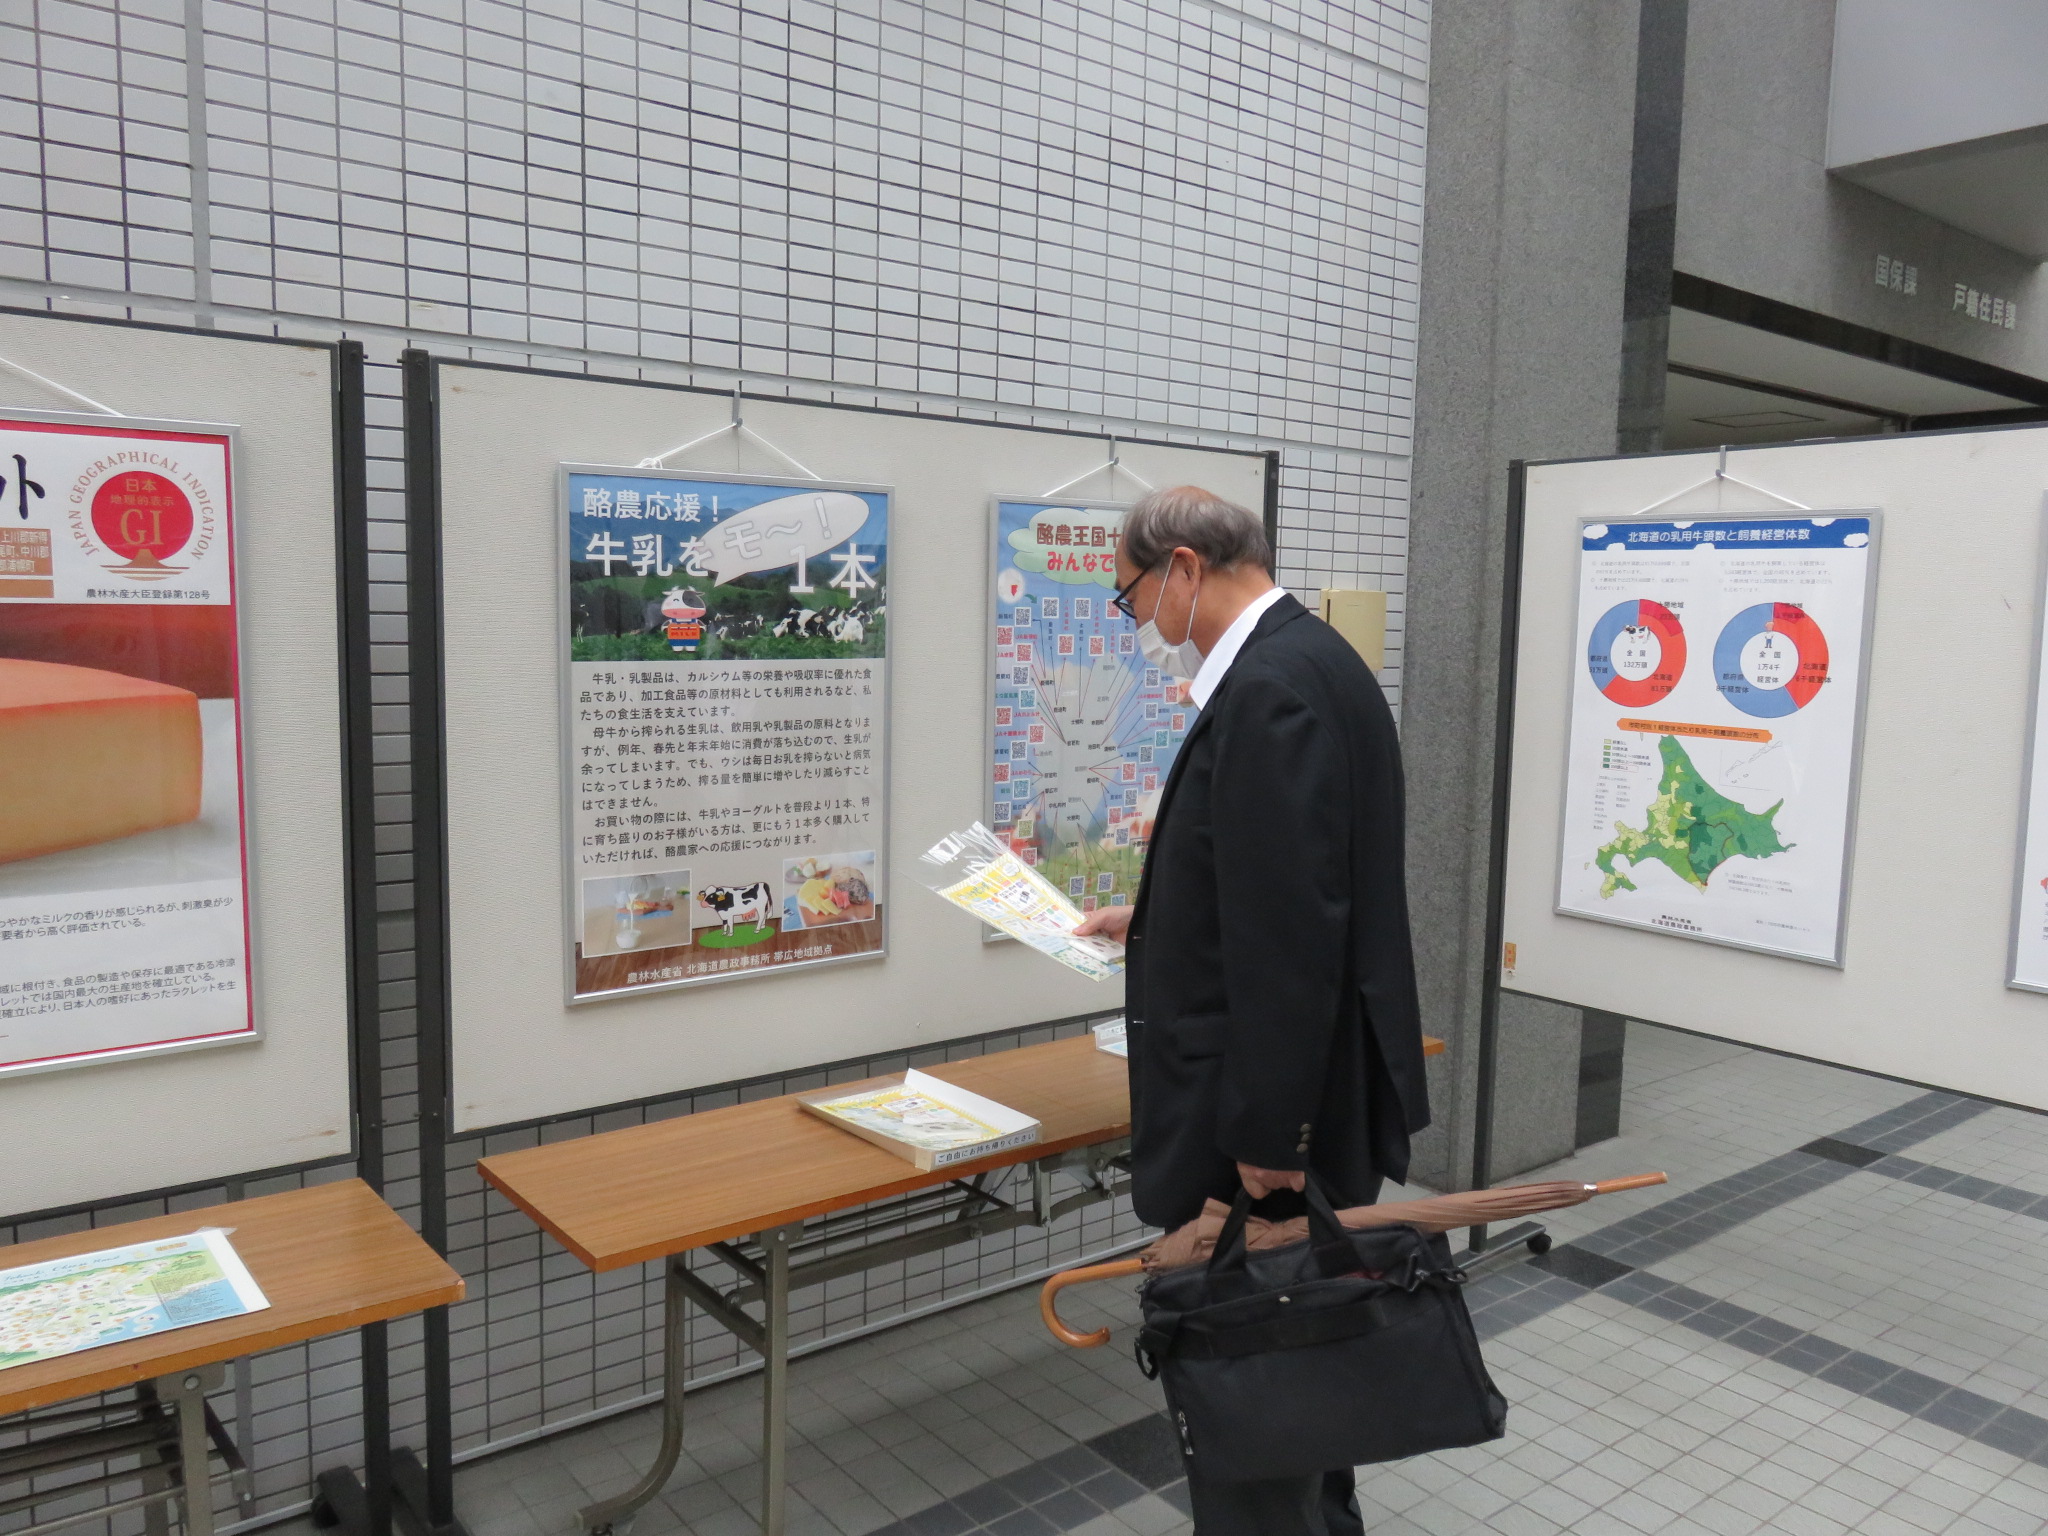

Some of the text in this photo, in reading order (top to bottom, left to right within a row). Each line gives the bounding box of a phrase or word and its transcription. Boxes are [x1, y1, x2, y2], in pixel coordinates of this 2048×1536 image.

[125, 479, 158, 492] 日本
[68, 451, 215, 560] JAPAN GEOGRAPHICAL INDICATION
[583, 487, 720, 523] 酪農応援！
[121, 509, 164, 546] GI
[1628, 528, 1811, 543] 北海道の乳用牛頭数と飼養経営体数
[586, 531, 714, 577] 牛乳を
[1047, 551, 1115, 573] みんなで
[86, 588, 211, 600] 農林水産大臣登録第128号
[580, 705, 736, 721] たちの食生活を支えています。
[582, 794, 659, 811] はできません。
[626, 965, 682, 984] 農林水産省
[686, 952, 771, 976] 北海道農政事務所
[938, 1133, 1035, 1163] ご自由にお持ち帰りください
